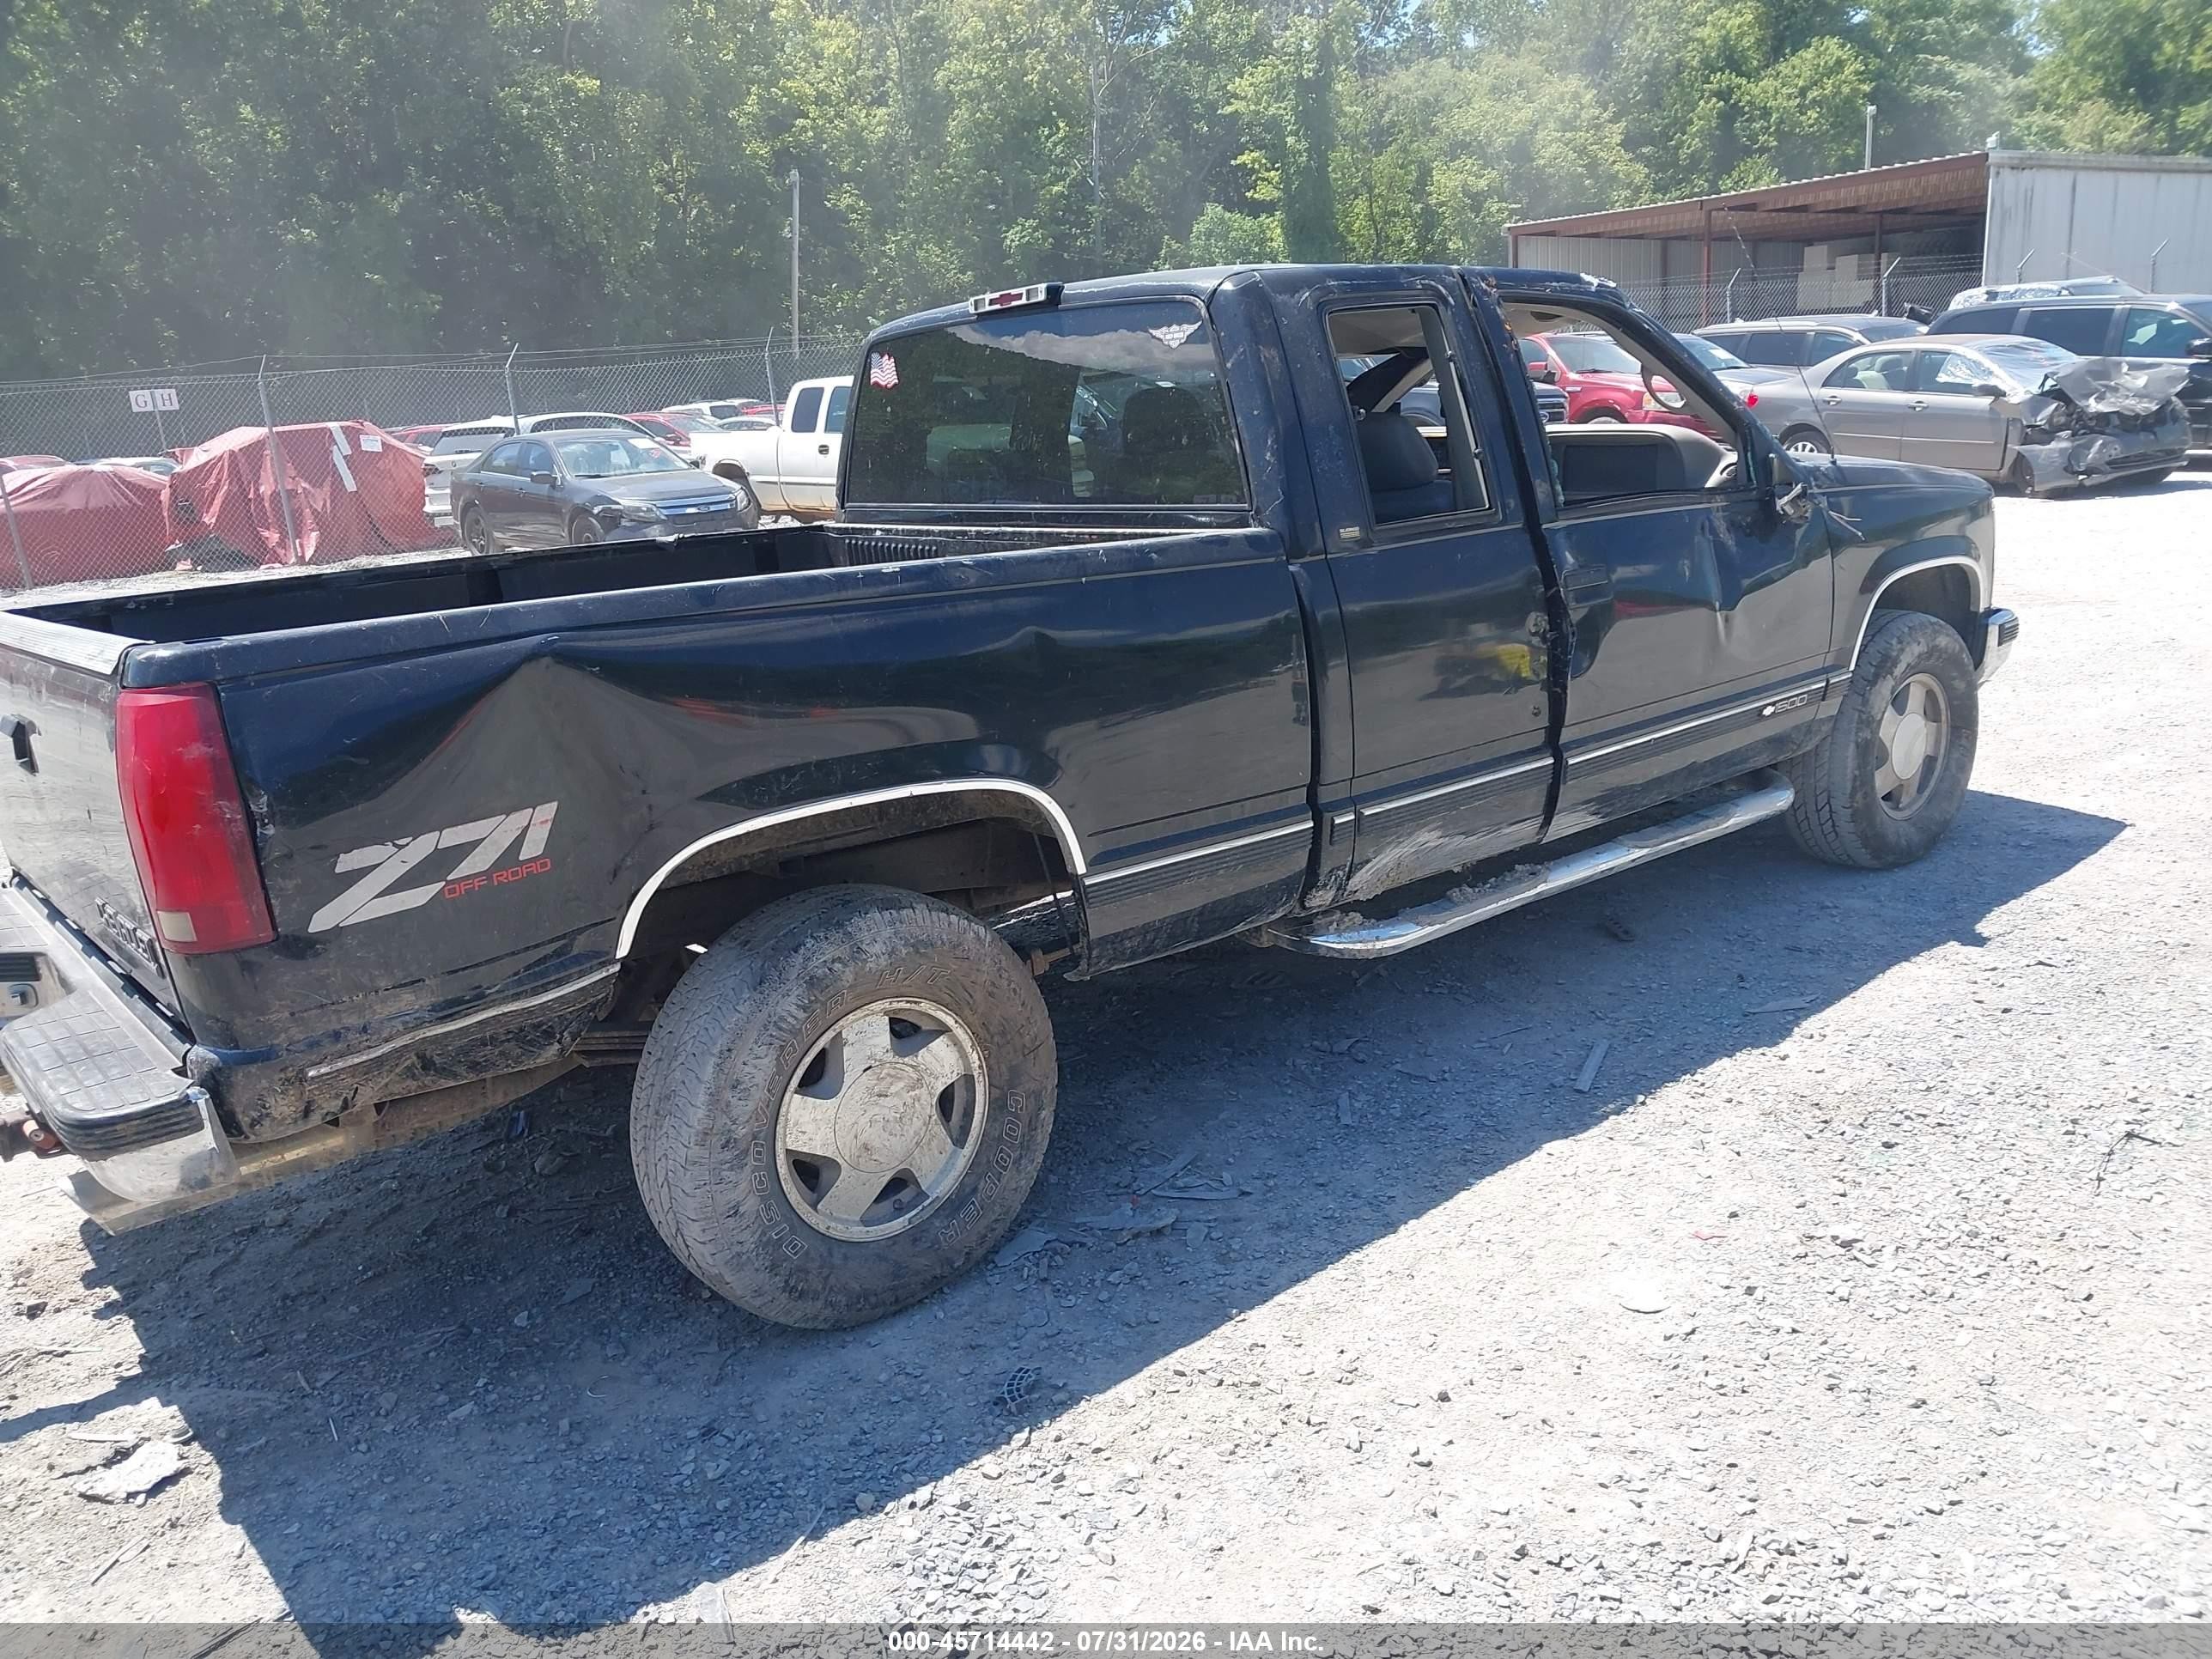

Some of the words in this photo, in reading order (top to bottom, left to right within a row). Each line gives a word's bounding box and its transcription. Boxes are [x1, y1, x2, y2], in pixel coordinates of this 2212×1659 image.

[135, 394, 148, 408] G
[161, 393, 173, 406] H
[307, 800, 558, 933] Z71
[444, 876, 488, 899] OFF
[493, 858, 551, 886] ROAD
[750, 989, 849, 1260] DISCOVERER
[876, 964, 951, 988] H/T
[938, 1089, 1026, 1245] COOPER
